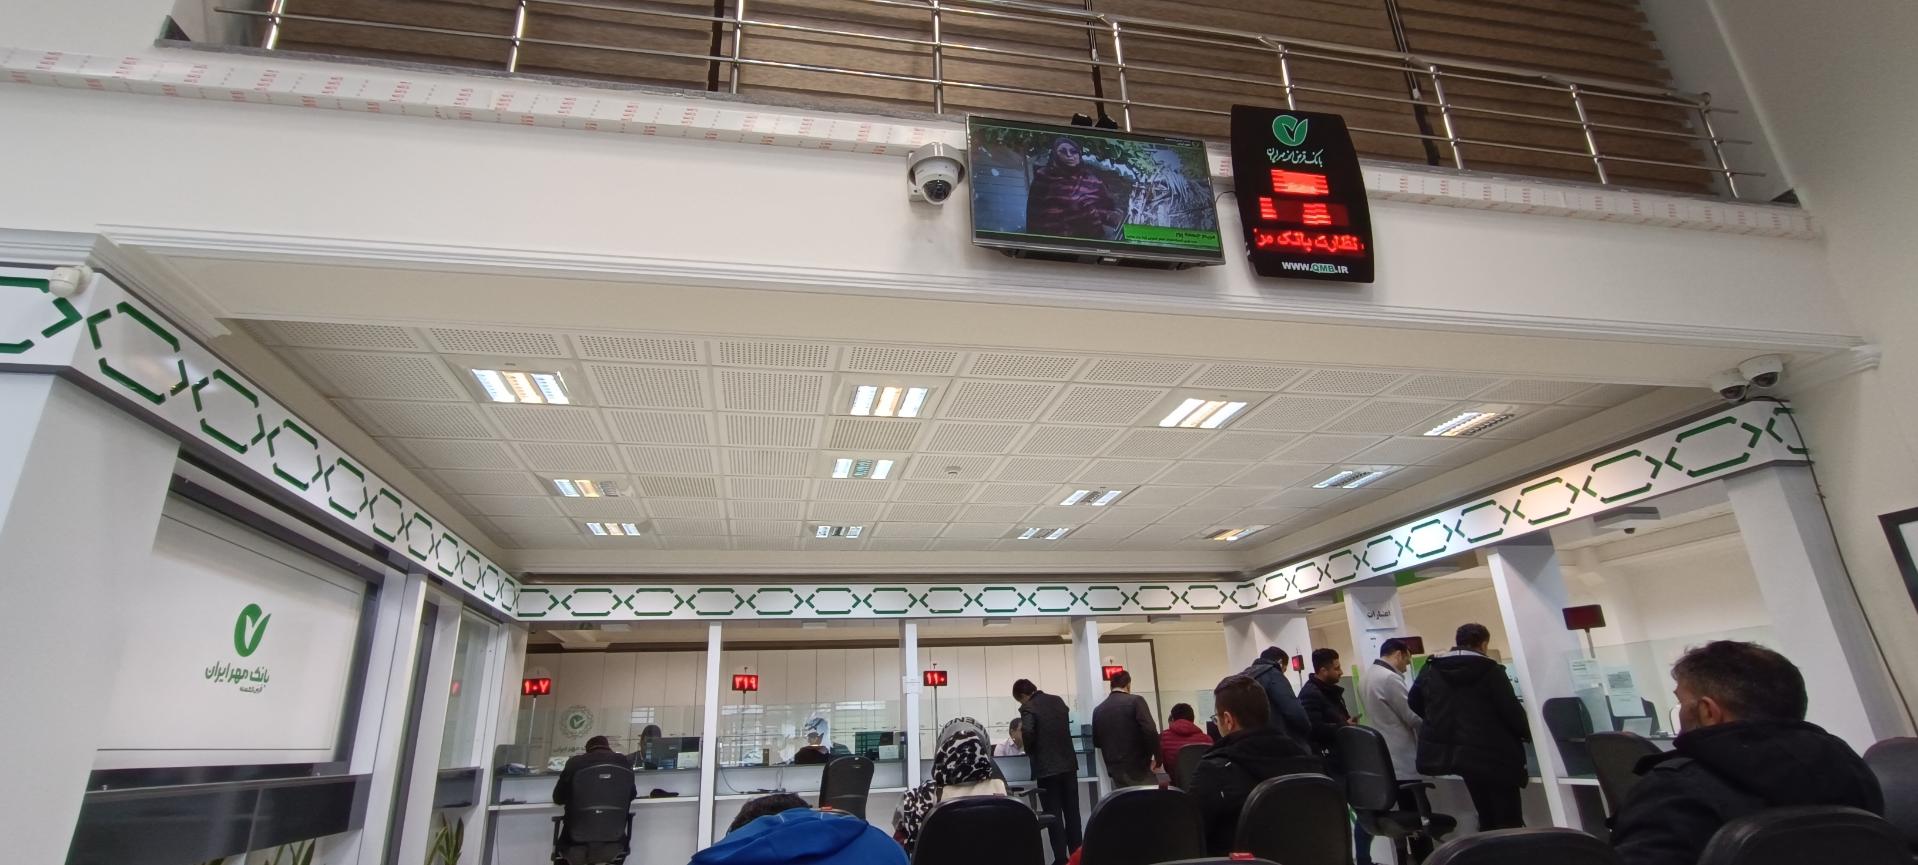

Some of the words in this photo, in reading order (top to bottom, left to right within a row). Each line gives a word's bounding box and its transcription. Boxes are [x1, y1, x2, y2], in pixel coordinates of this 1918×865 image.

[1304, 149, 1324, 168] بانک
[1277, 230, 1312, 253] بانک
[1315, 233, 1358, 253] نظارت
[1282, 261, 1349, 274] WWW.QMB.IR
[205, 660, 231, 683] ایران
[227, 667, 249, 684] مهر
[249, 666, 270, 687] بانک
